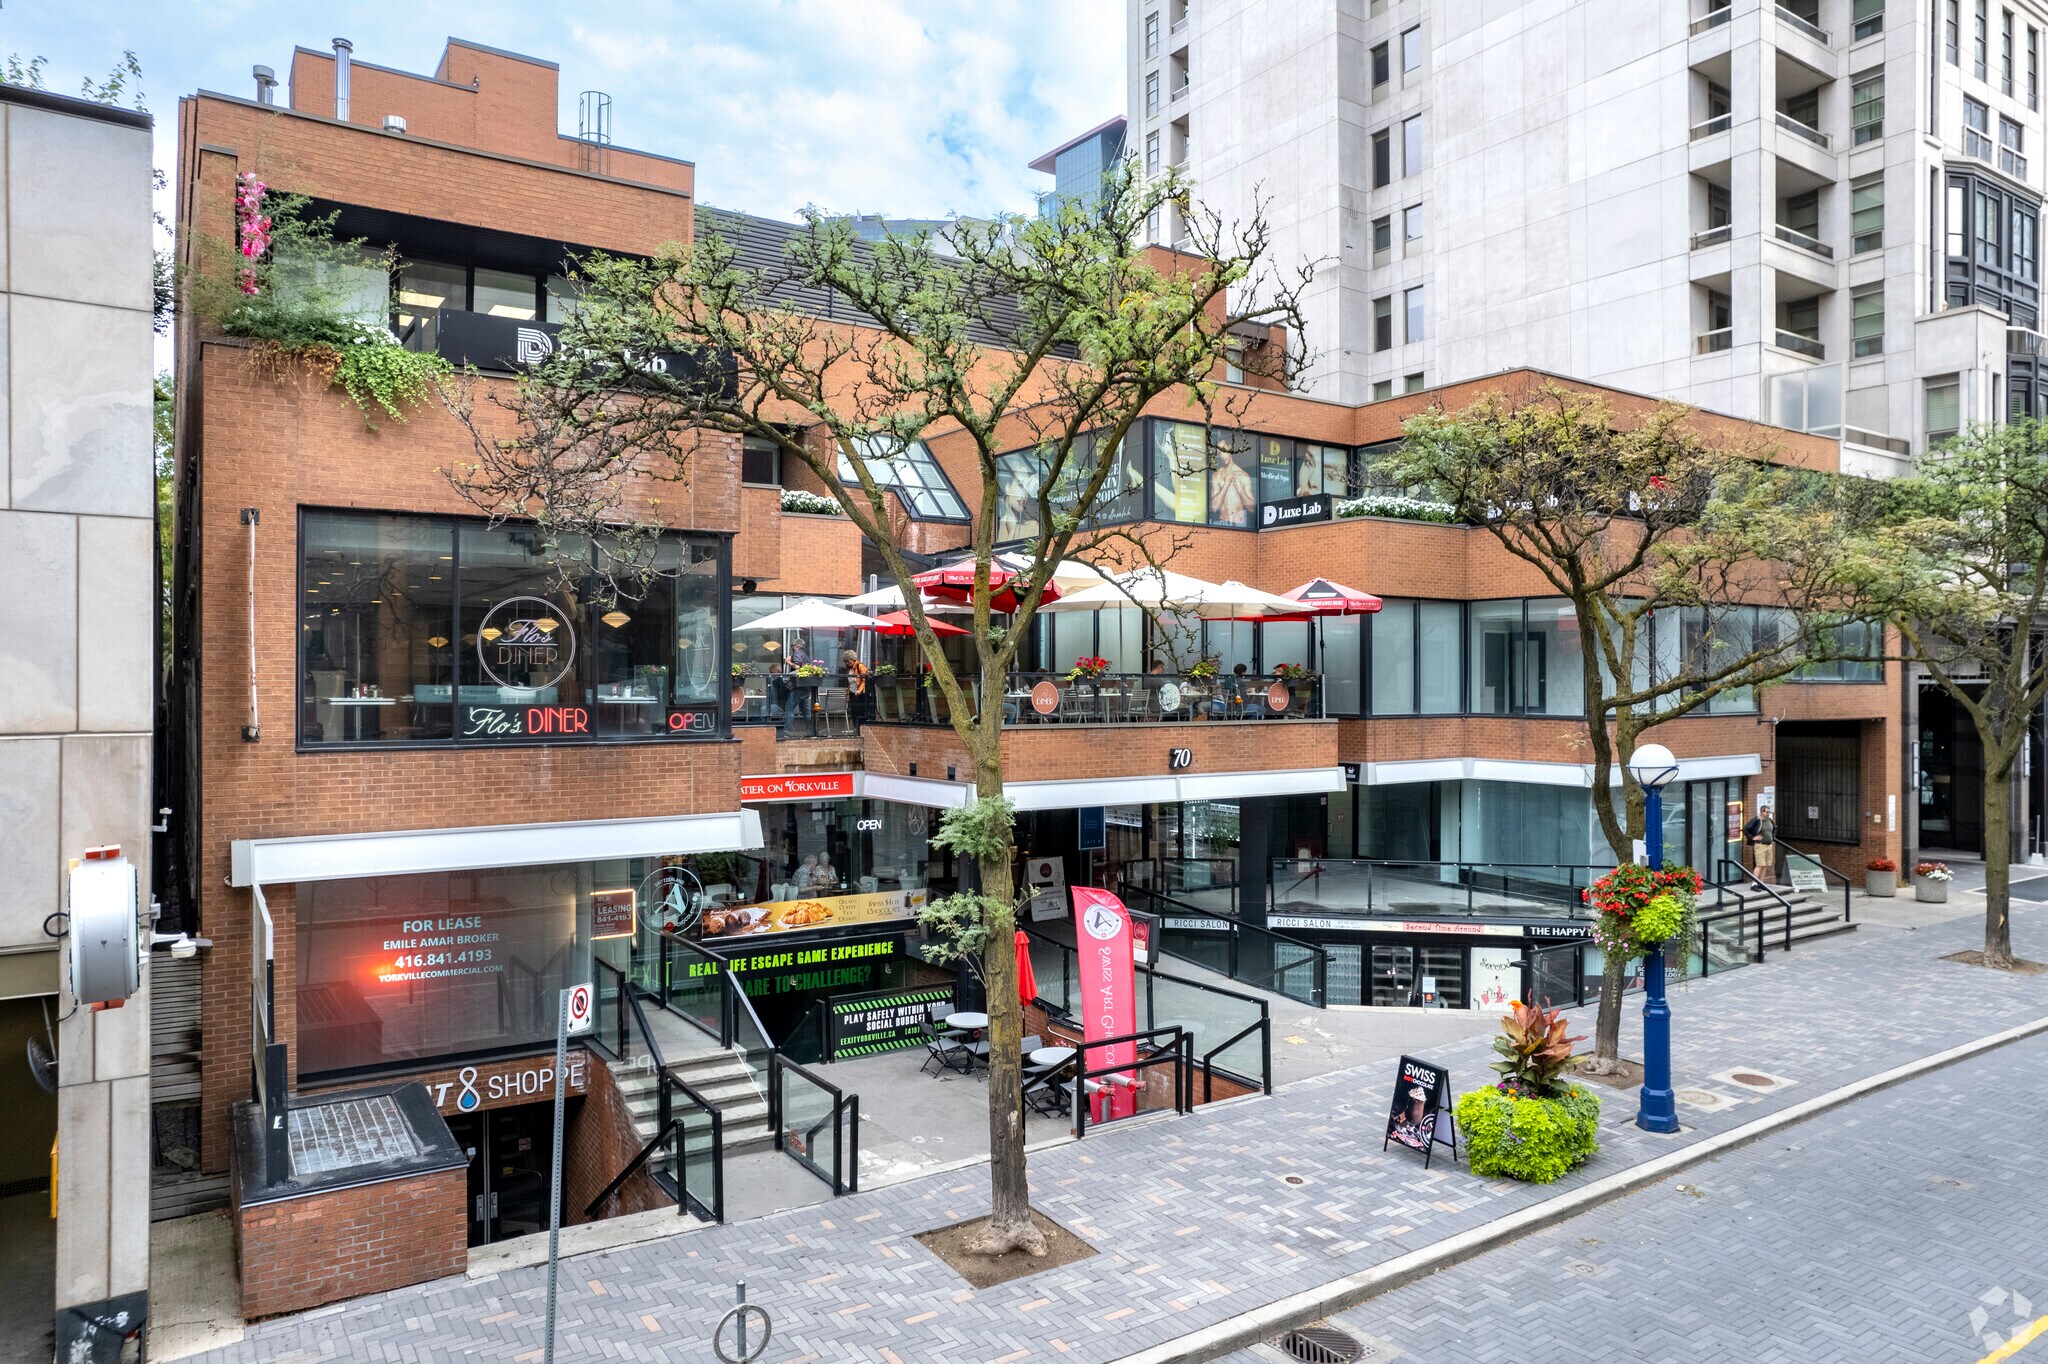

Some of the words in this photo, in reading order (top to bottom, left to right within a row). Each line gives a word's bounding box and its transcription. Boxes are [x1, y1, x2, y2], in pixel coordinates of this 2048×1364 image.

[1278, 456, 1290, 466] Lab
[1278, 506, 1302, 520] Luxe
[1302, 502, 1322, 516] Lab
[497, 646, 558, 665] DINER
[464, 708, 522, 735] Flo's
[528, 707, 588, 734] DINER
[669, 712, 715, 731] OPEN
[1173, 748, 1191, 768] 70
[768, 784, 782, 792] ON
[785, 780, 839, 792] YORKVILLE
[857, 819, 882, 831] OPEN
[598, 904, 632, 915] LEASING
[403, 919, 434, 933] FOR
[438, 916, 482, 930] LEASE
[1174, 920, 1197, 928] RICCI
[1200, 920, 1228, 928] SALON
[1276, 918, 1300, 927] RICCI
[1303, 919, 1332, 928] SALON
[1530, 926, 1550, 936] THE
[1552, 928, 1586, 936] HAPPY
[384, 939, 417, 950] EMILE
[420, 936, 454, 948] AMAR
[456, 932, 500, 944] BROKER
[394, 949, 492, 968] 416.841.4193
[689, 962, 718, 978] REAL
[730, 958, 747, 972] IFE
[752, 953, 794, 970] ESCAPE
[797, 949, 828, 964] GAME
[831, 942, 894, 960] EXPERIENCE
[379, 964, 503, 982] YORKVILLECOMMERCIAL.COM
[740, 978, 770, 998] ARE
[844, 1012, 864, 1025] PLAY
[866, 1008, 895, 1021] SAFELY
[898, 1004, 924, 1016] WITHIN
[866, 1019, 893, 1032] SOCIAL
[840, 1030, 896, 1046] EEXITYORKVILLE.CA
[488, 1063, 584, 1100] SHOPE
[1404, 1063, 1436, 1084] SWISS
